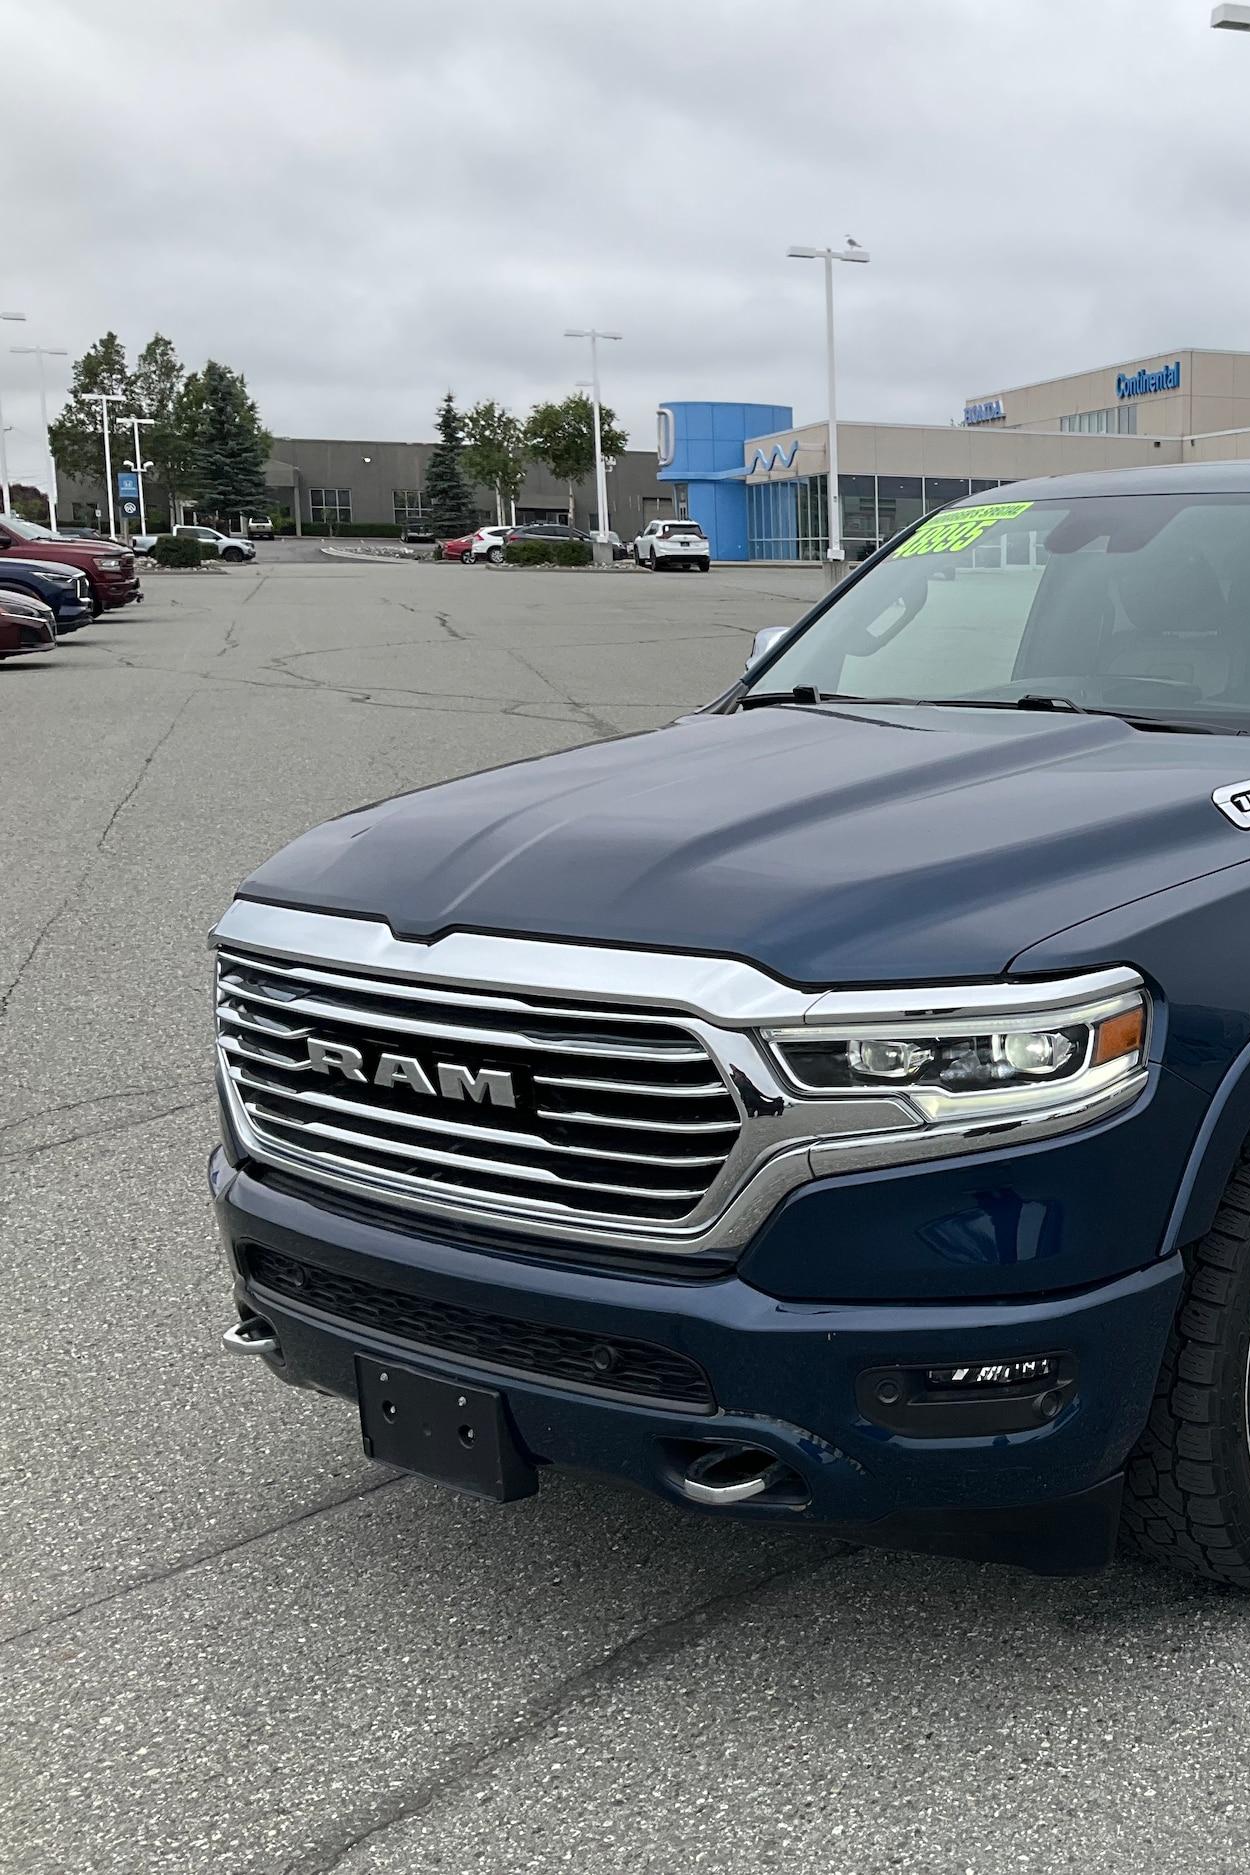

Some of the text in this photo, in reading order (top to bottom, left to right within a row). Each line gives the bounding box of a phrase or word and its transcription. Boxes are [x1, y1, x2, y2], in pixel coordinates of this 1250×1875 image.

[1116, 361, 1180, 399] Continental
[964, 400, 1005, 424] HONDA
[307, 1037, 516, 1108] RAM
